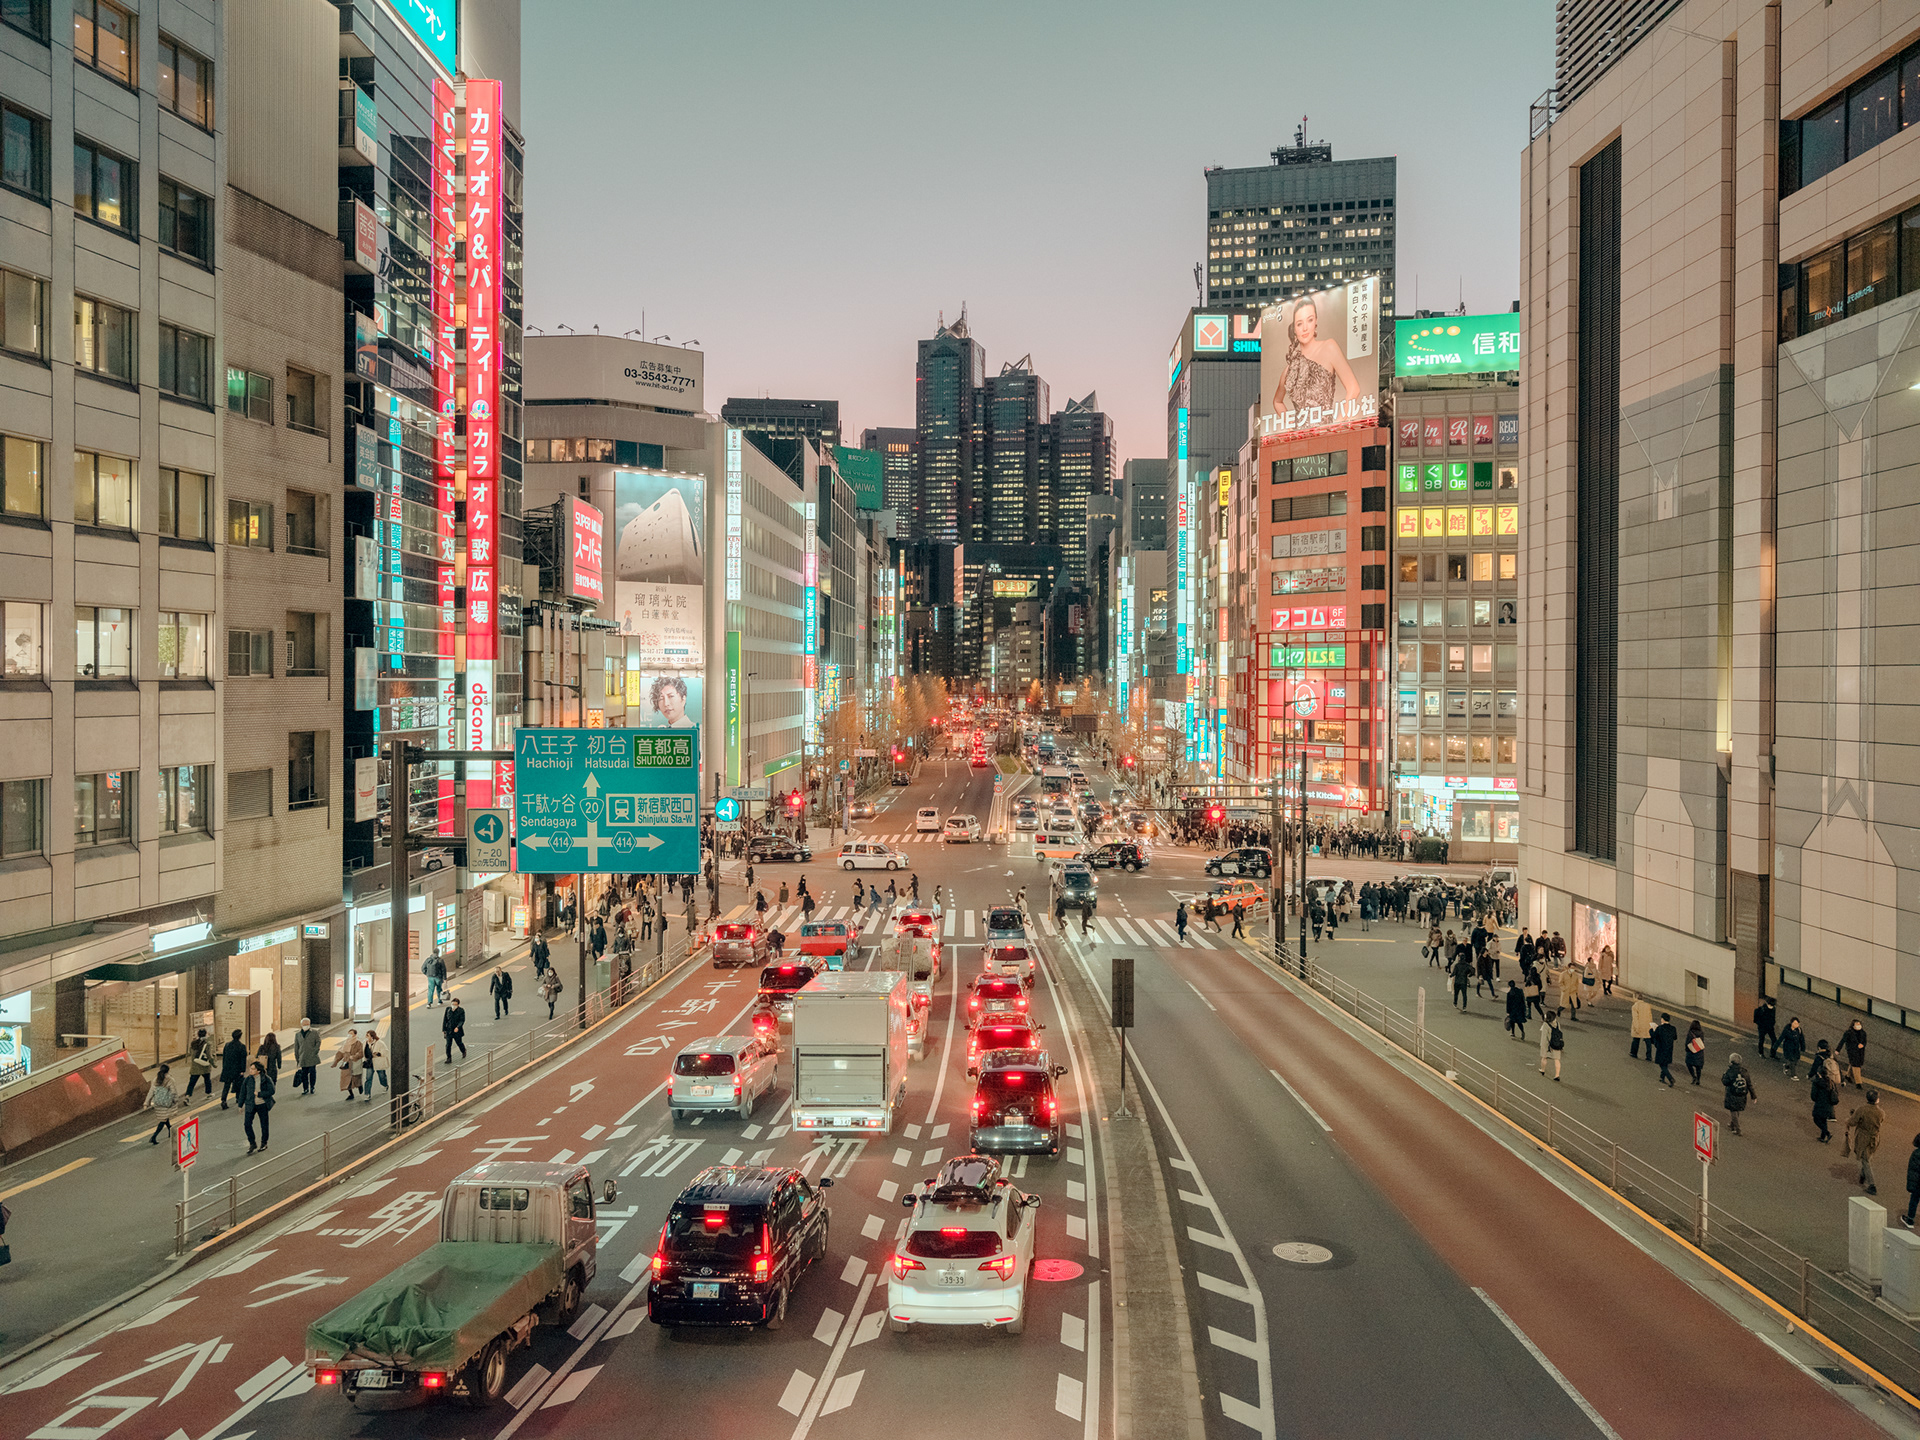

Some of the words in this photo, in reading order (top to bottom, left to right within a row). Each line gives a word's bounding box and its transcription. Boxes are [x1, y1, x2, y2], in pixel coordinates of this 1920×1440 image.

[408, 0, 447, 42] ーオン
[1405, 353, 1462, 366] SHINWA
[639, 360, 681, 375] 広告募集中
[624, 367, 696, 388] 03-3543-7771
[635, 379, 685, 394] www.hit-ad.co.jp
[1262, 394, 1376, 433] THEグローバル社
[1402, 464, 1464, 479] ほぐし
[854, 482, 877, 493] MIWA
[575, 511, 591, 531] SUPER
[1179, 501, 1187, 527] LABI
[471, 427, 490, 624] カラオケ歌広場
[1400, 515, 1466, 532] 占い館
[1291, 532, 1327, 546] 新宿駅前
[1179, 531, 1187, 568] SHINJUKU
[996, 581, 1026, 591] やまや
[1291, 575, 1346, 589] エーアイアール
[634, 592, 687, 608] 瑠璃光院
[1275, 608, 1326, 628] アコム
[1332, 607, 1344, 617] 6F
[590, 716, 602, 729] 大
[520, 735, 578, 755] 八王子
[586, 734, 627, 755] 初台
[636, 738, 689, 756] 首都高
[526, 757, 573, 771] Hachioji
[585, 757, 630, 769] Hatsudai
[636, 756, 674, 766] SHUTOKO
[675, 756, 691, 766] EXP
[1315, 792, 1344, 801] Kitchen
[585, 802, 599, 814] 20
[637, 797, 693, 814] 新宿駅西口
[520, 815, 577, 829] Sendagaya
[637, 814, 669, 825] Shinjuku
[552, 836, 570, 848] 414
[615, 836, 632, 848] 414
[476, 848, 503, 858] 7-20
[471, 858, 508, 868] この先50m
[944, 1276, 964, 1284] 39-39
[363, 1376, 386, 1387] 37-41
